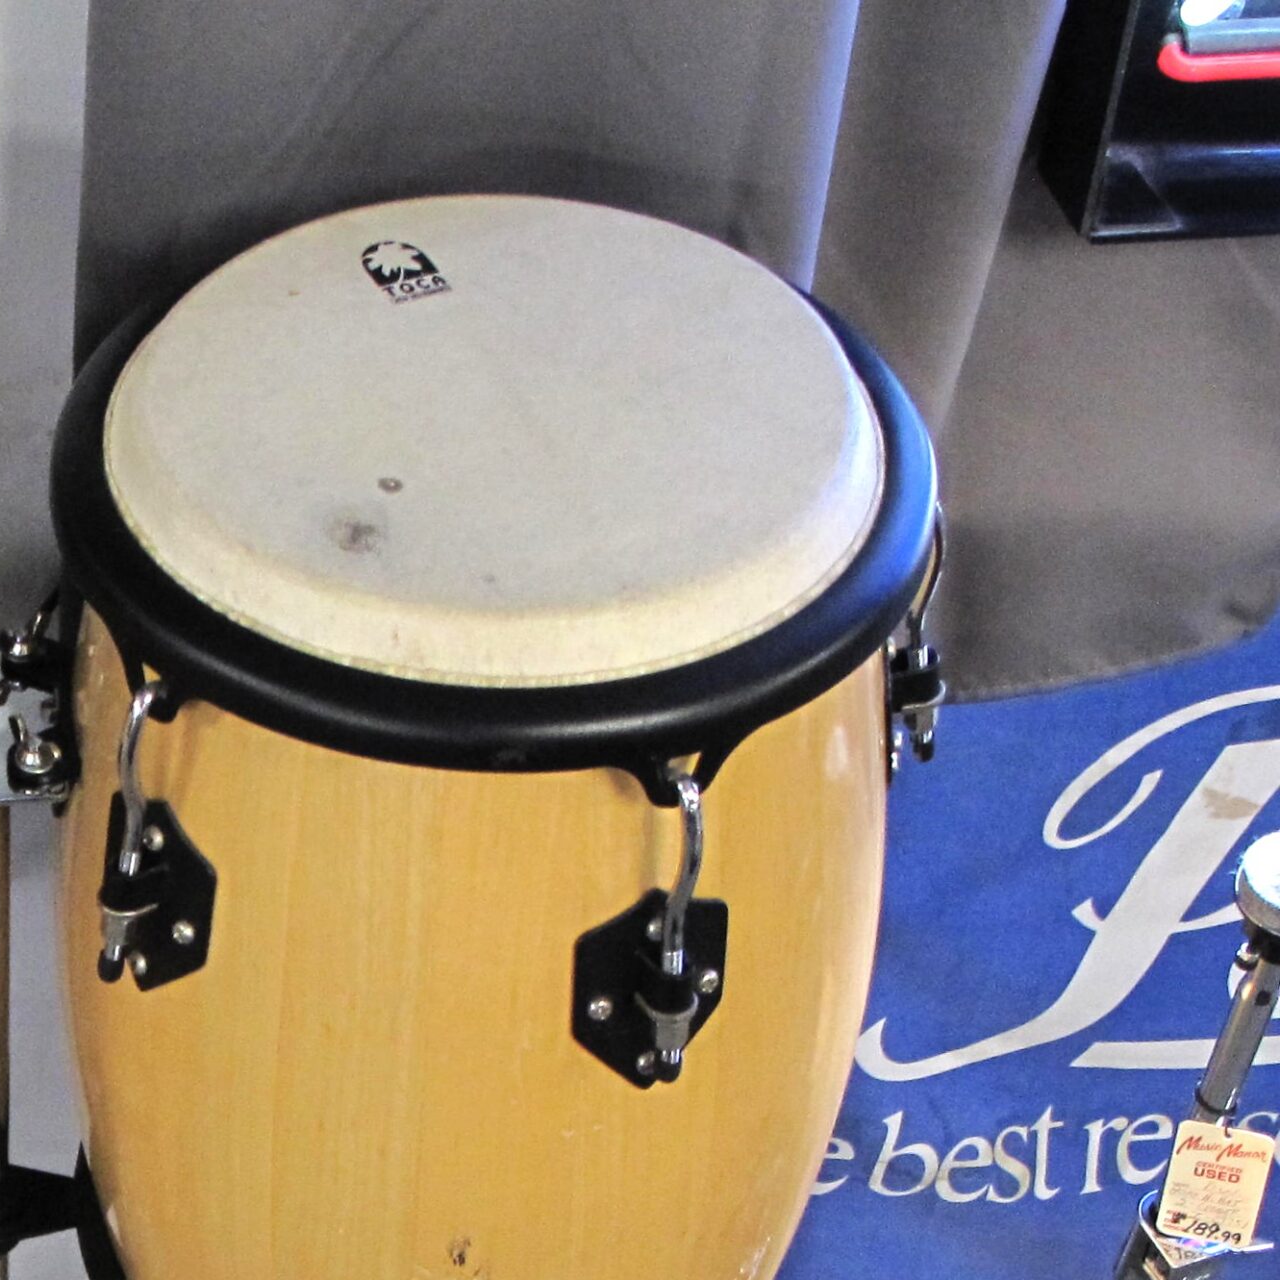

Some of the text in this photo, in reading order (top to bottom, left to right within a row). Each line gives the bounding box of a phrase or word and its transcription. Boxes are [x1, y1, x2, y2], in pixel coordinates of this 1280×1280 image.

[382, 274, 447, 297] TOCA
[868, 1104, 1064, 1204] best
[1194, 1167, 1240, 1184] USED
